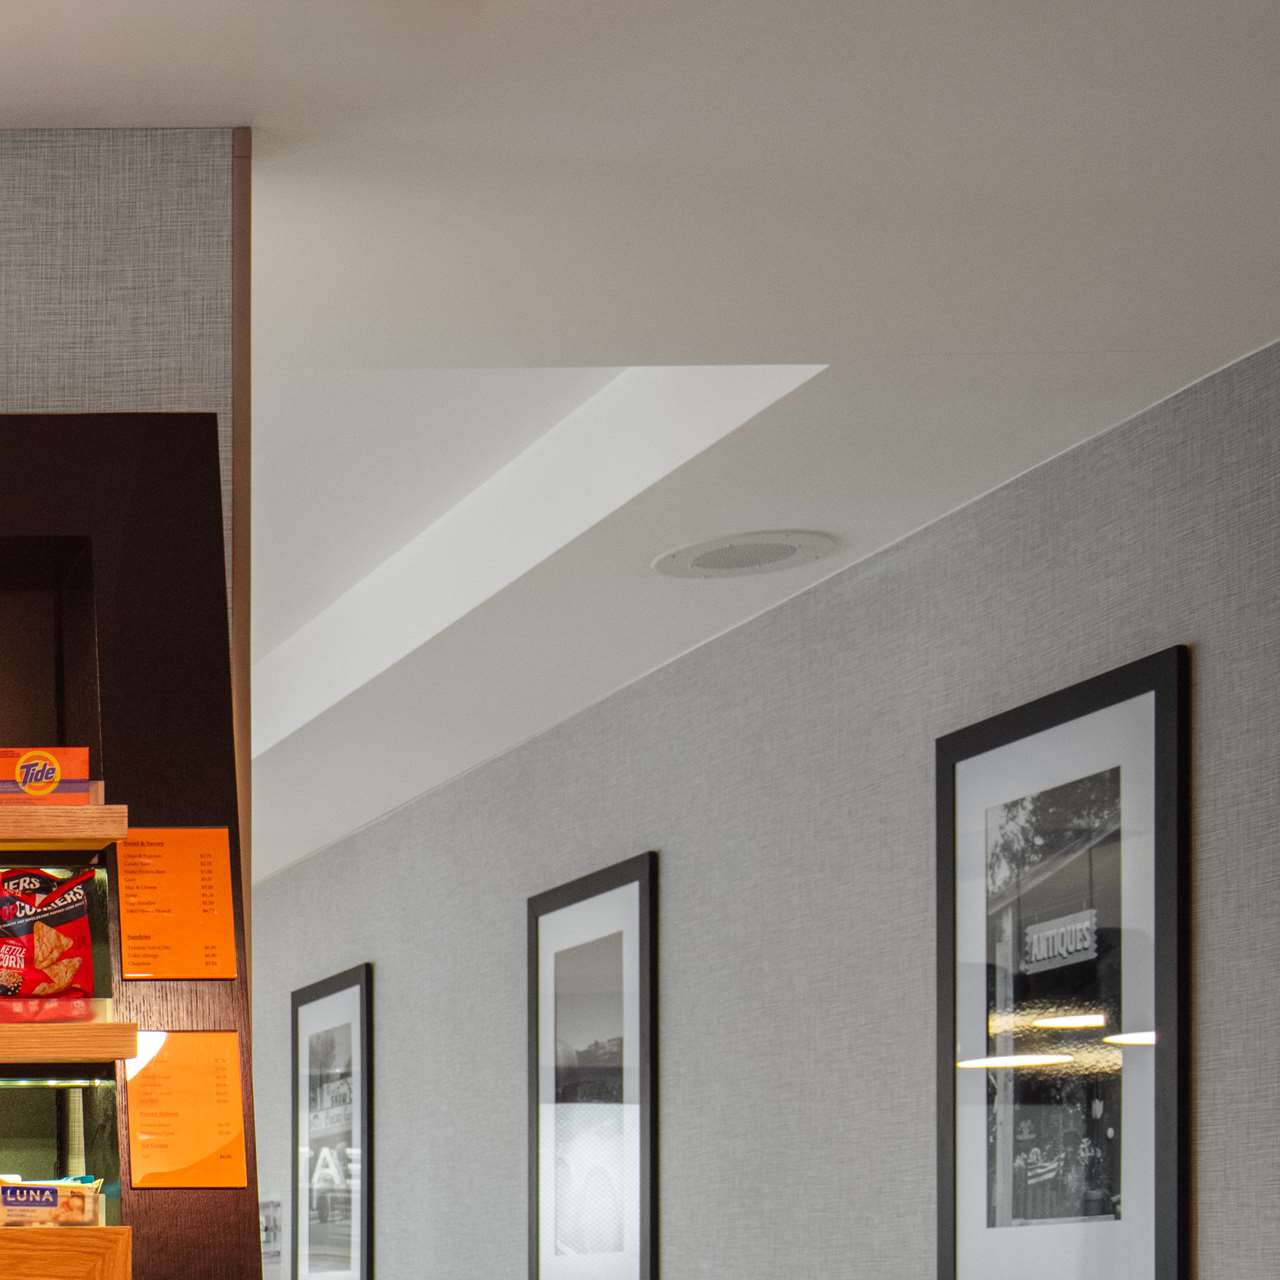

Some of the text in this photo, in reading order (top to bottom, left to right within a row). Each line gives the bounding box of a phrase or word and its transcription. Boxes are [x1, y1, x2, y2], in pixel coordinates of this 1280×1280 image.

[18, 761, 58, 786] Tide
[1032, 921, 1090, 961] ANTIQUES
[0, 945, 26, 958] KETTLE
[6, 1189, 54, 1202] LUNA
